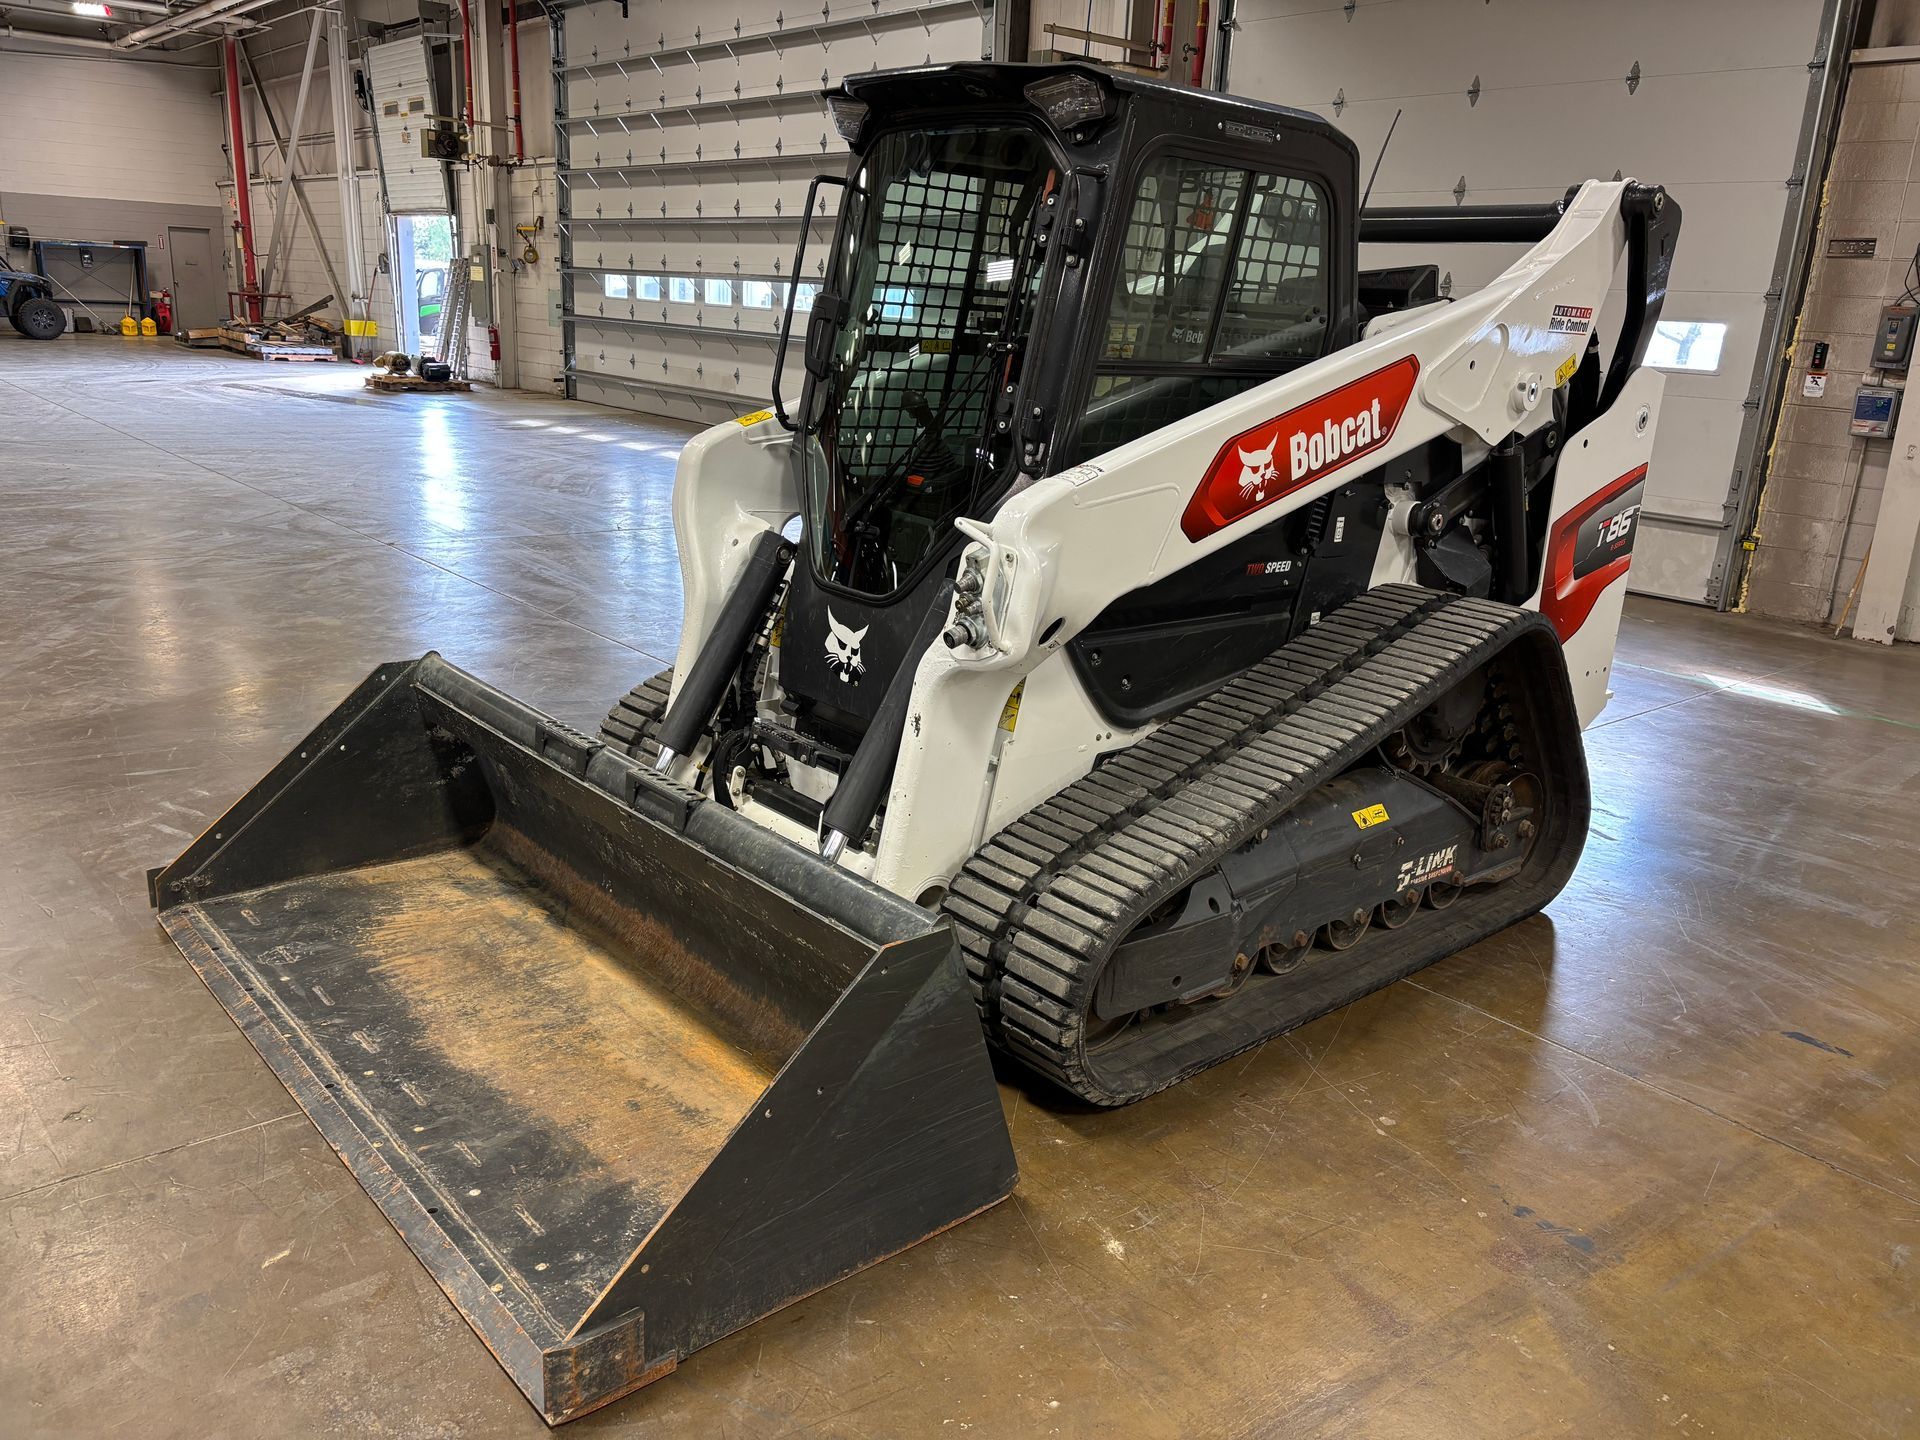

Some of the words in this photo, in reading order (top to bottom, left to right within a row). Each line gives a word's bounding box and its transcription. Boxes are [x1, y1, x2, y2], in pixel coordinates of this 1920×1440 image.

[1553, 306, 1592, 318] AUTOMATIC
[1549, 317, 1565, 331] Ride
[1565, 319, 1590, 332] Control
[1289, 398, 1381, 481] Bobcat
[1247, 563, 1265, 575] TWO
[1265, 561, 1291, 573] SPEED
